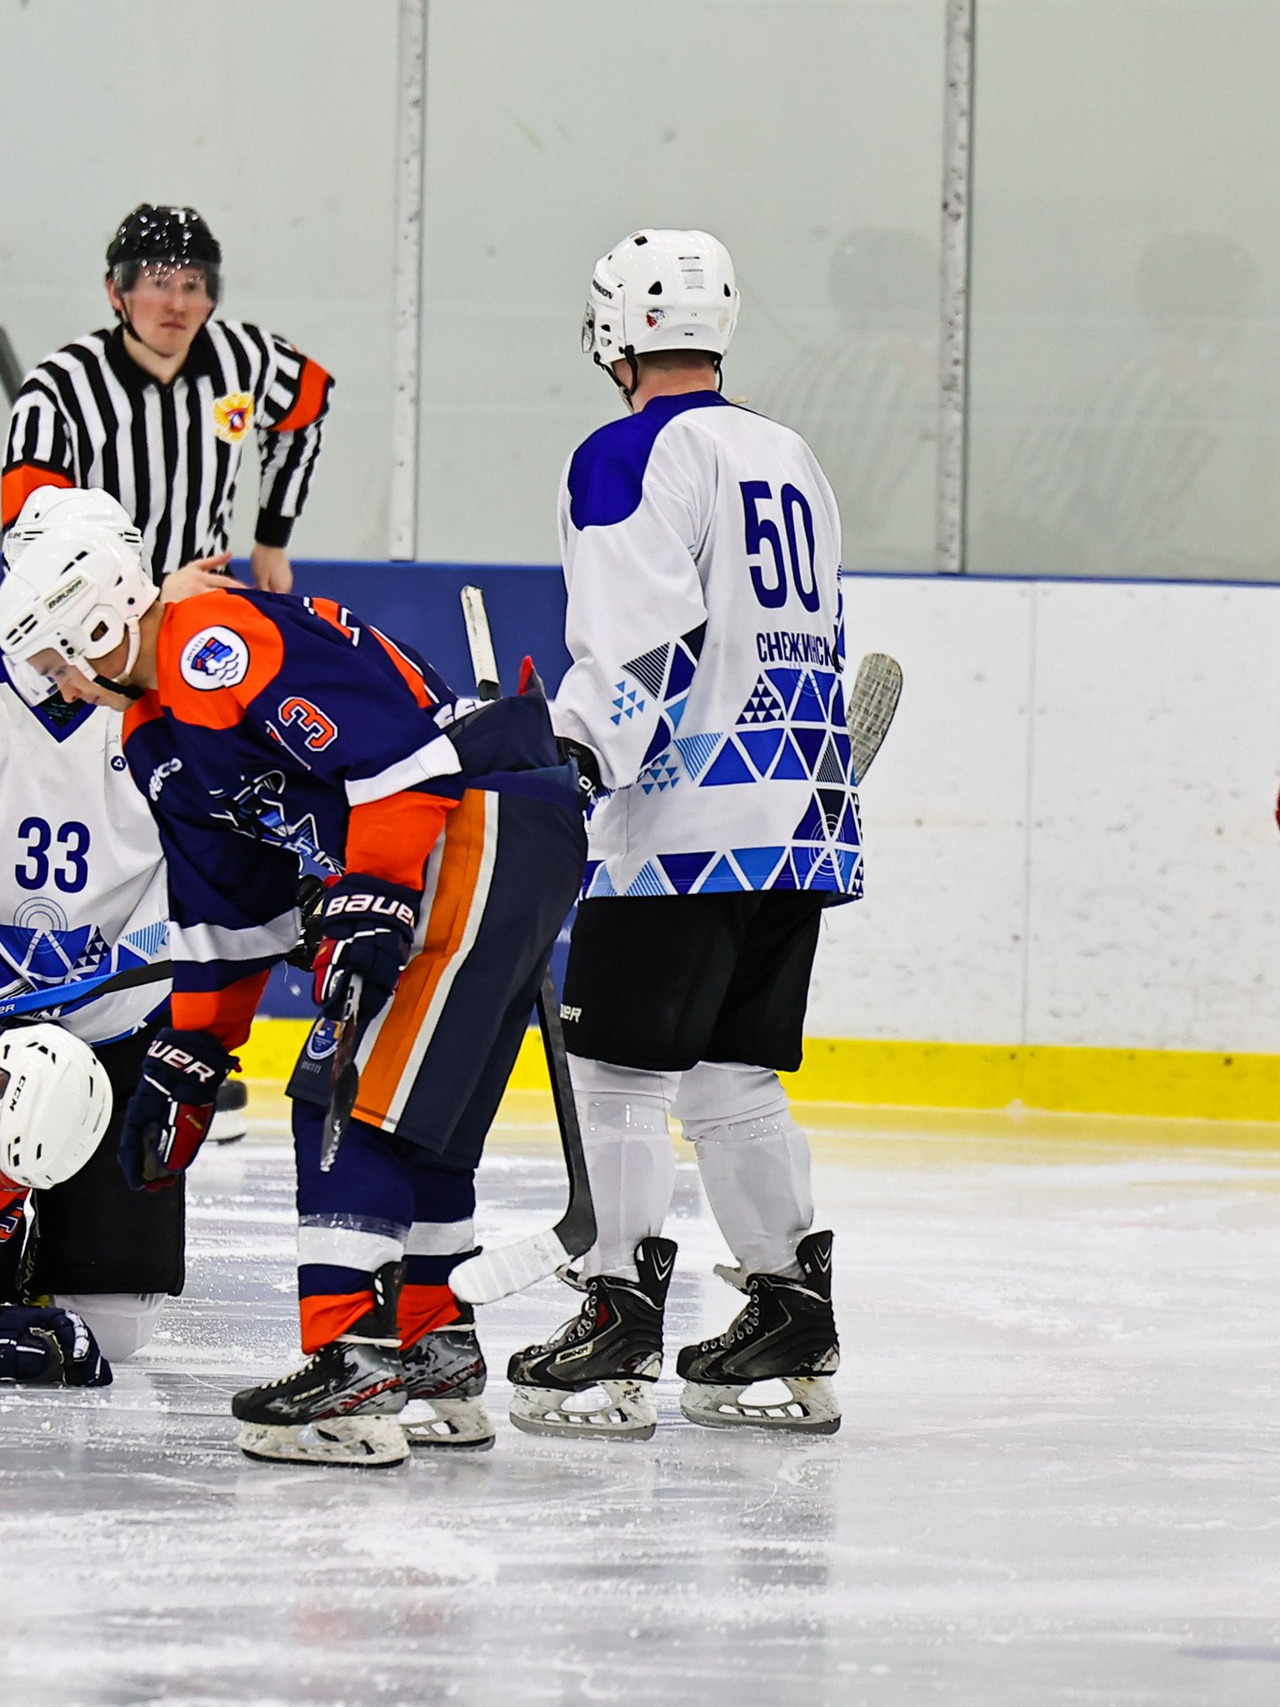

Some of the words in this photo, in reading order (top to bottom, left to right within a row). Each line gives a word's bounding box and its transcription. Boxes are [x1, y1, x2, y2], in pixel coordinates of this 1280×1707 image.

[739, 480, 820, 613] 50
[15, 816, 91, 893] 33
[9, 1075, 26, 1112] CCM
